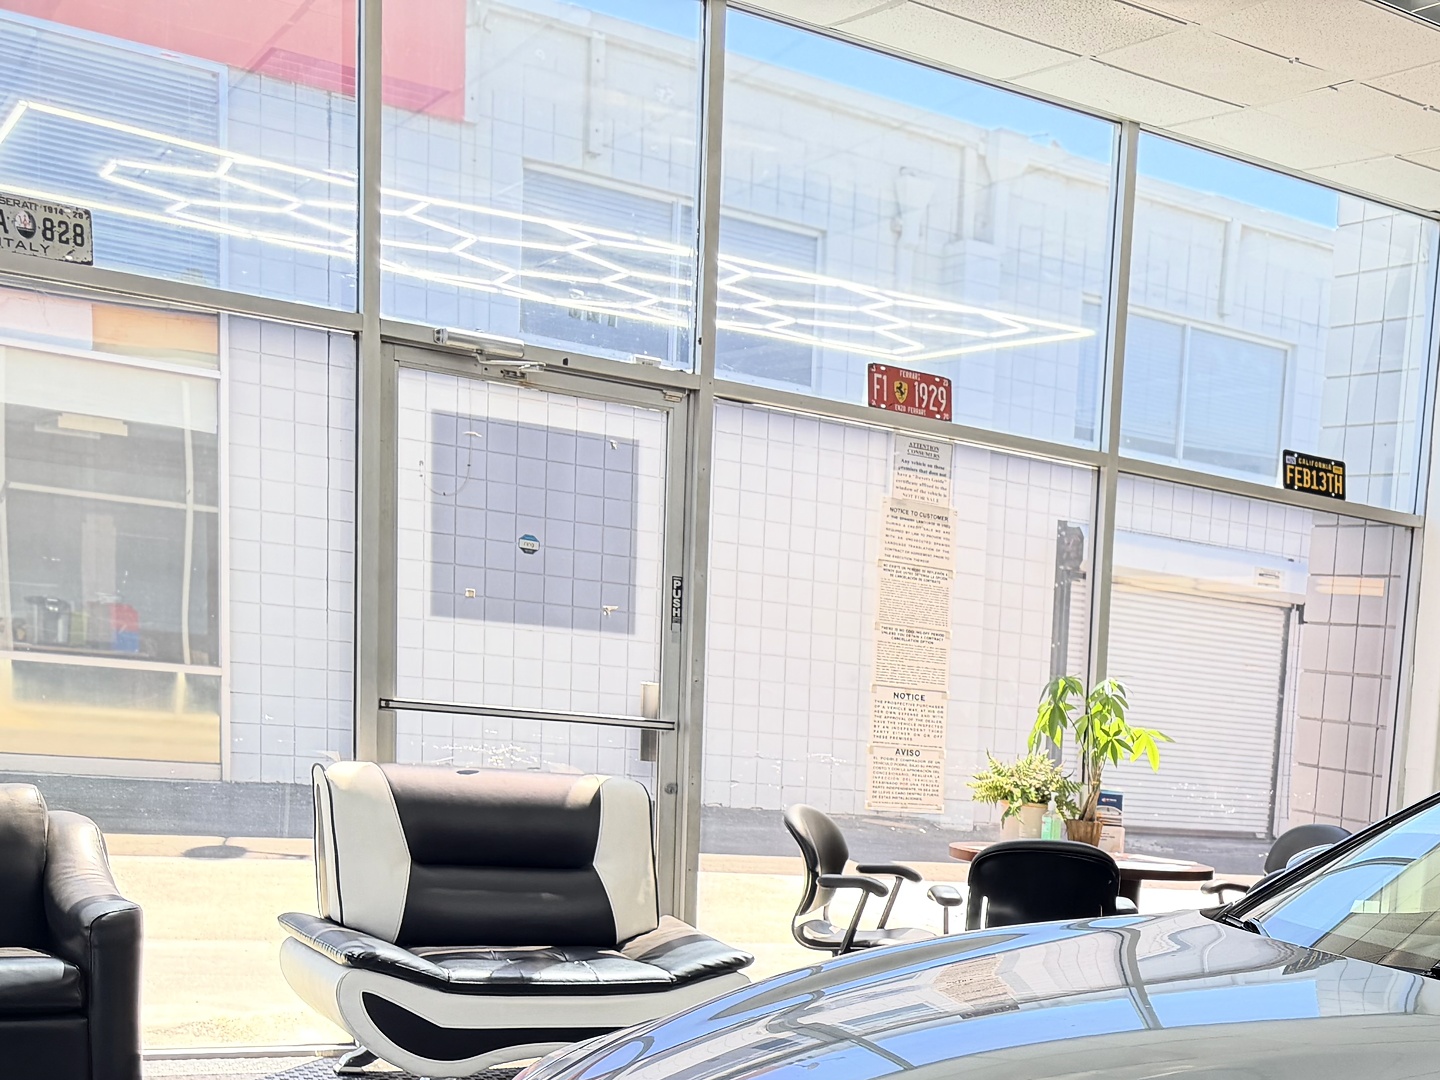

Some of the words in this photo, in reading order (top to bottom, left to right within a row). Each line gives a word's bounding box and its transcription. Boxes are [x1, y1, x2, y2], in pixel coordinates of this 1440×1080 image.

[42, 217, 85, 248] 828
[873, 373, 888, 402] F1
[914, 381, 947, 412] 1929
[1286, 464, 1343, 495] FEB13TH
[890, 507, 909, 515] NOTICE
[672, 579, 682, 617] PUSH
[893, 692, 925, 701] NOTICE
[895, 748, 920, 757] AVISO
